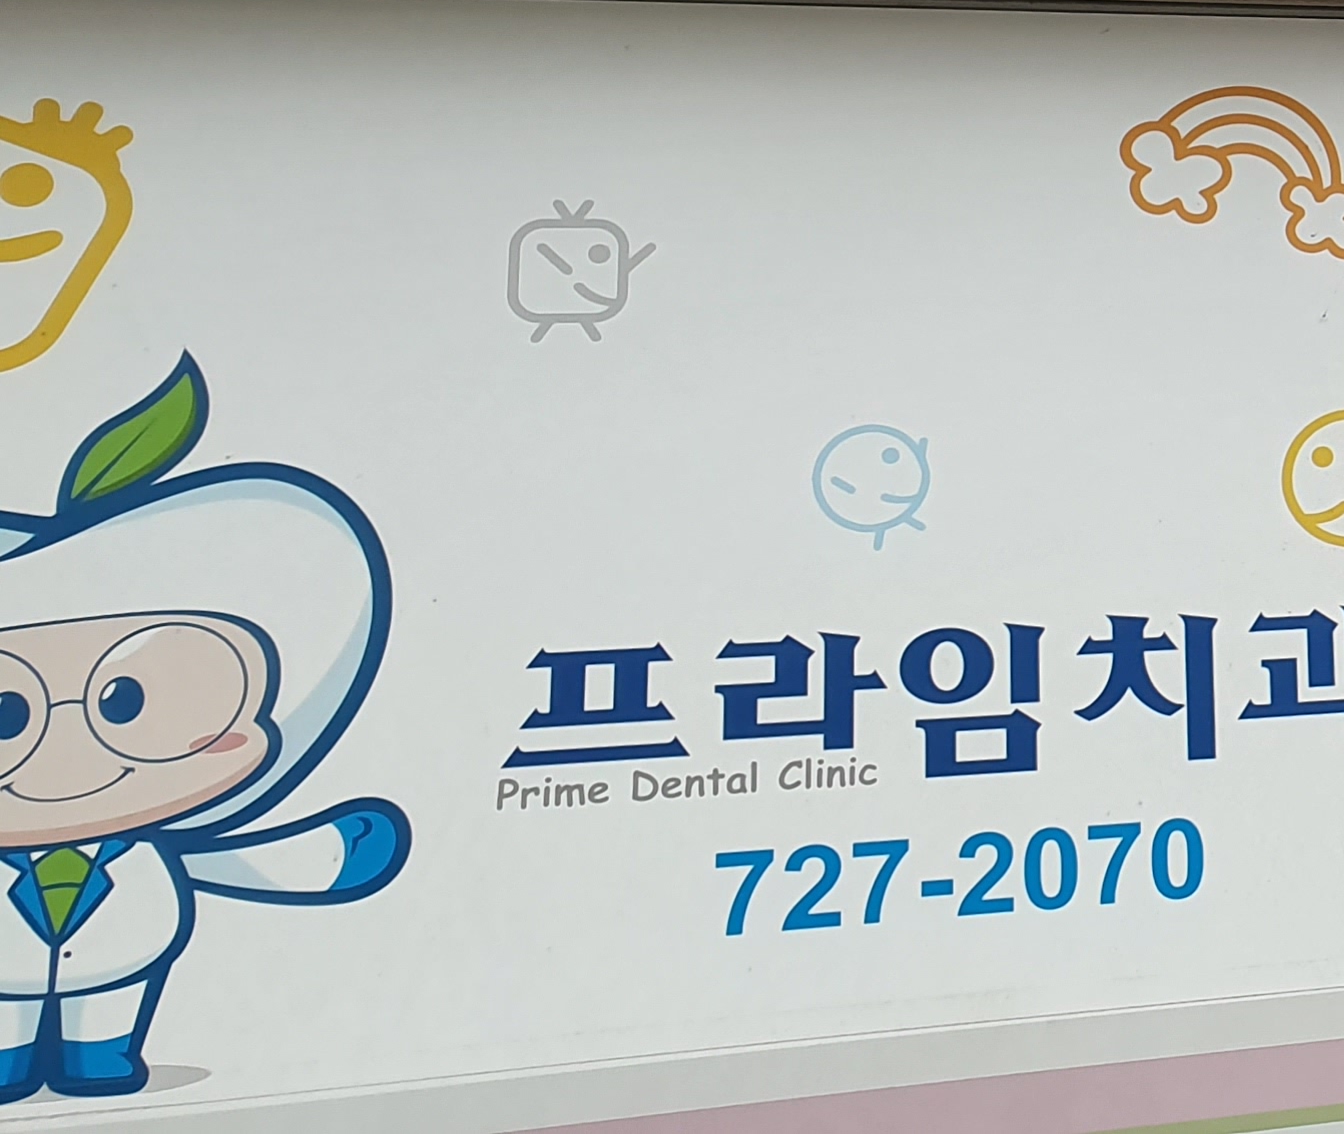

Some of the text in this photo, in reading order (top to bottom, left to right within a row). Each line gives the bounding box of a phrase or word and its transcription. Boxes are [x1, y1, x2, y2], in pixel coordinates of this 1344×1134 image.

[495, 755, 879, 812] Prime Dental Clinic
[714, 816, 1205, 937] 727-2070
